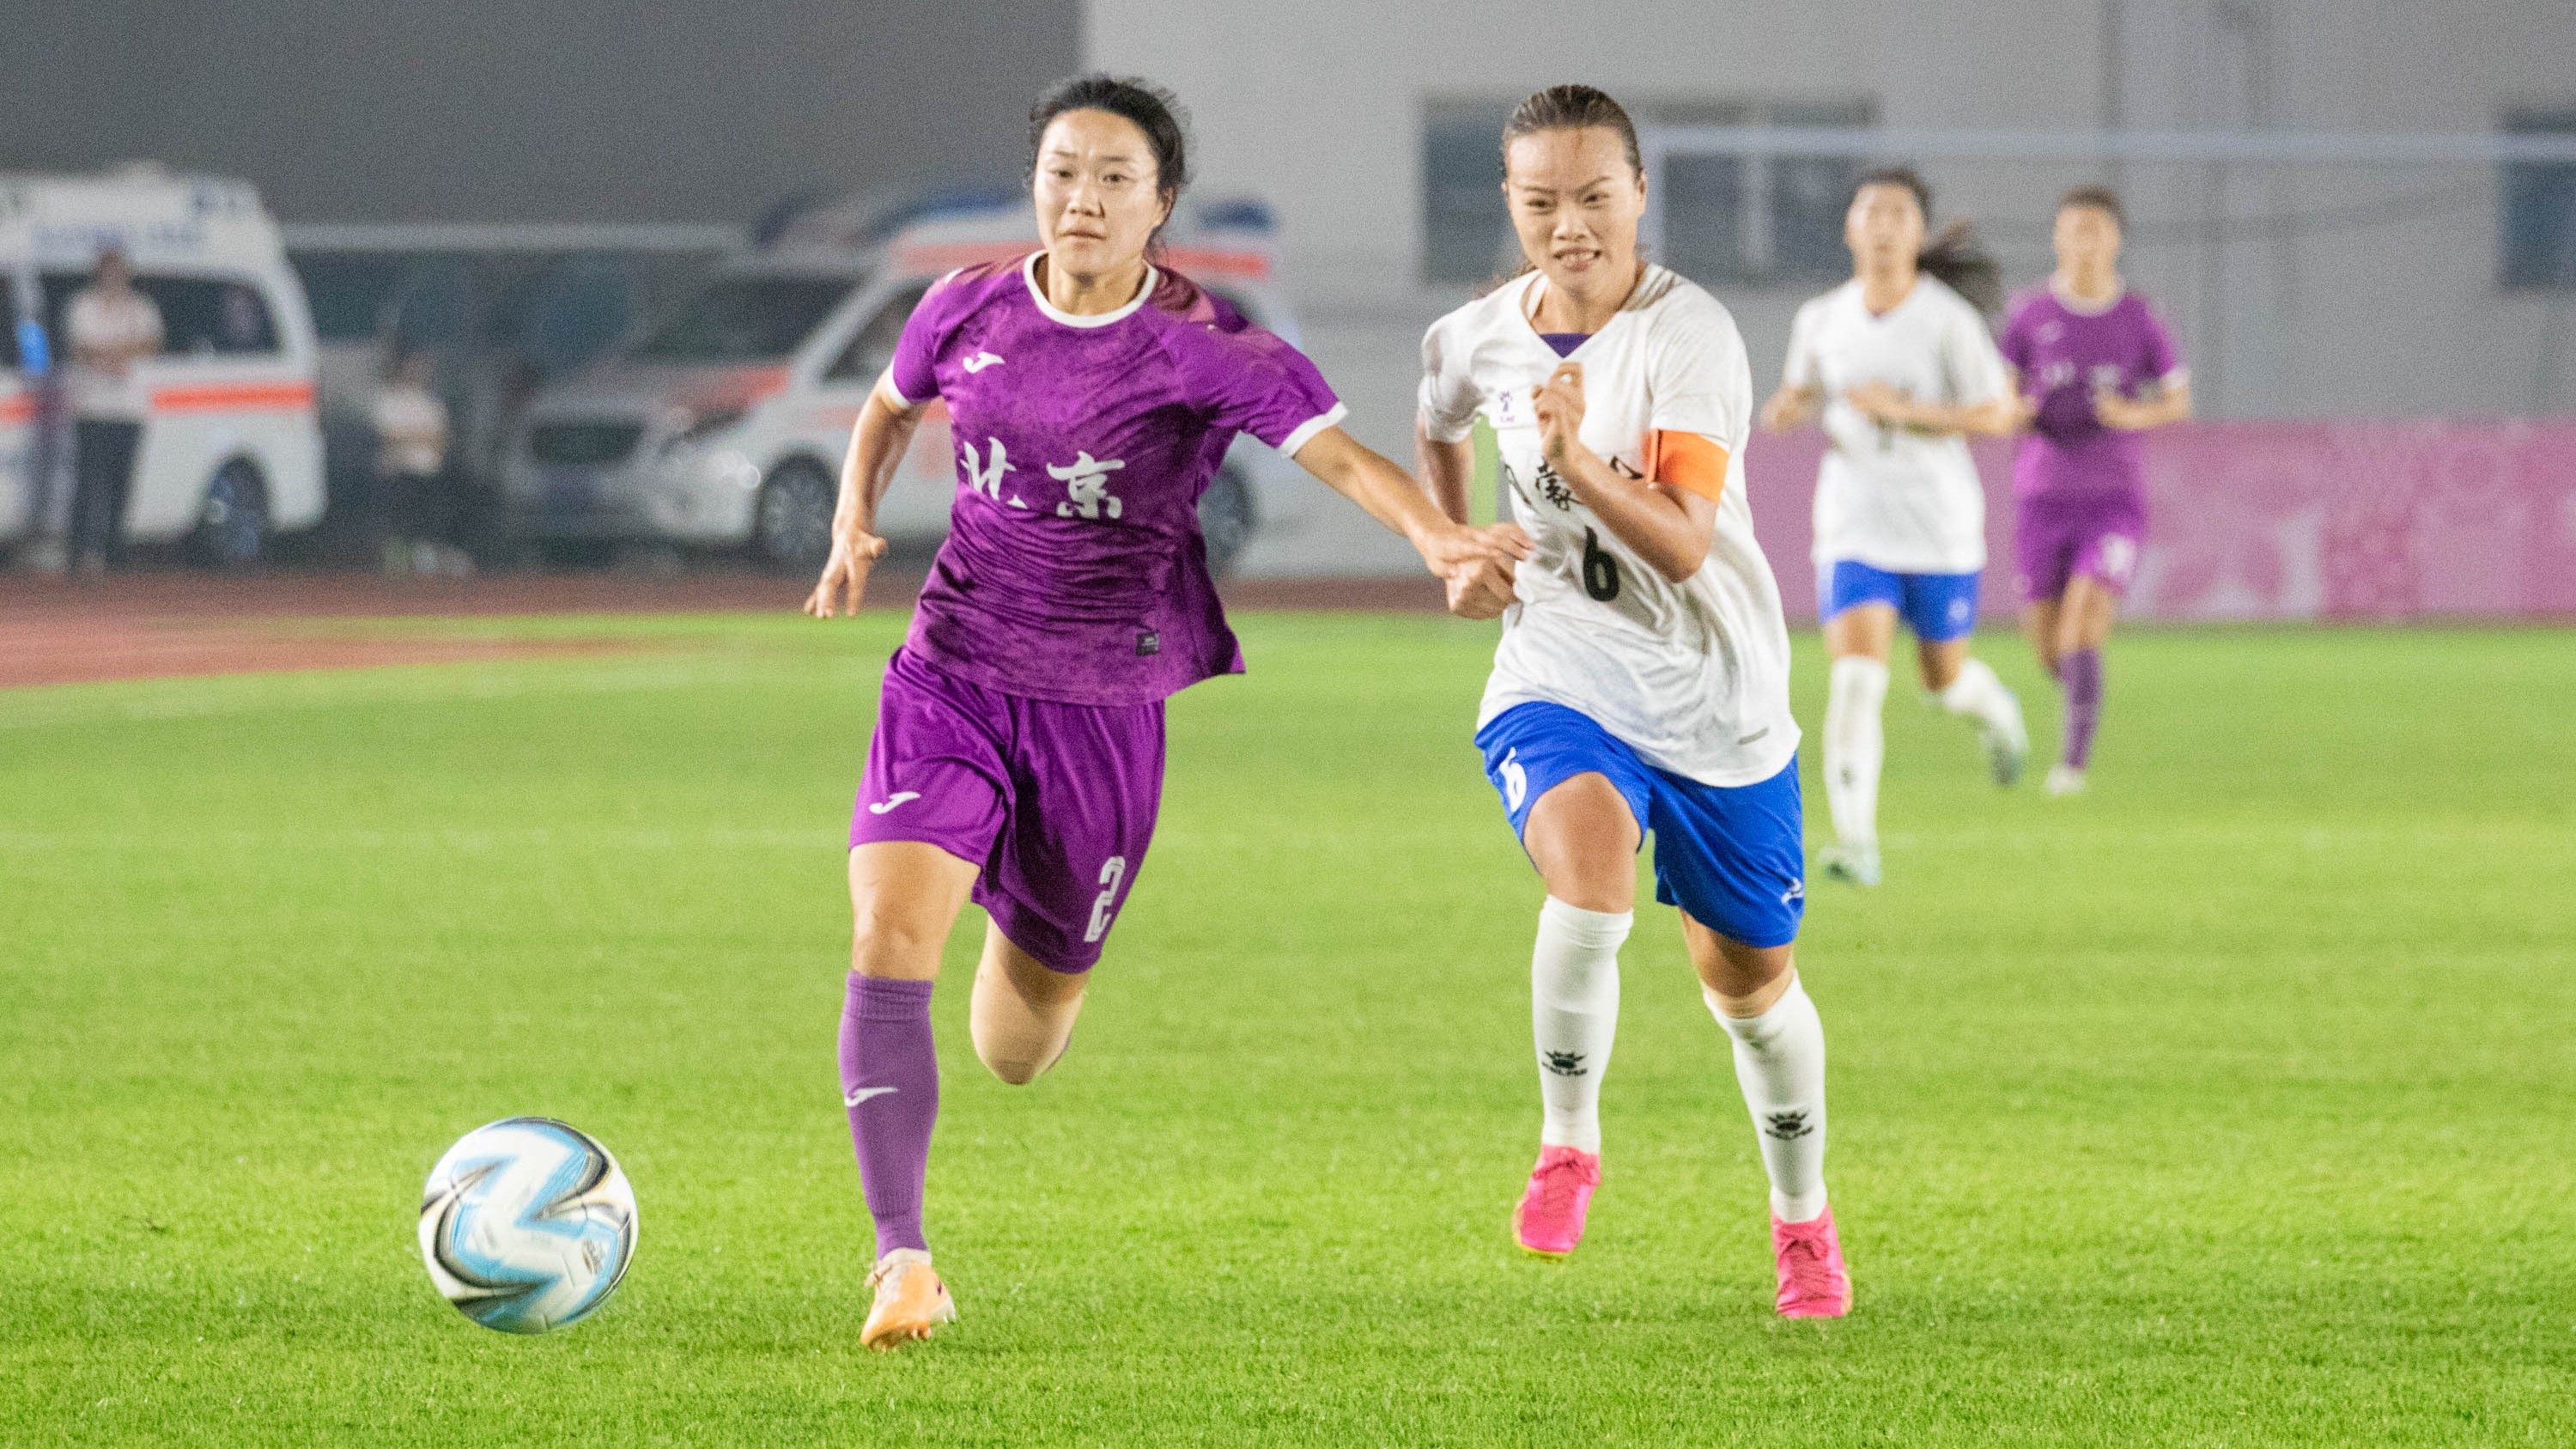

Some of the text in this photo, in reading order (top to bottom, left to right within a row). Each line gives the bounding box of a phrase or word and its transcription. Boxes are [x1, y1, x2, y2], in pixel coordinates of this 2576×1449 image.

[959, 436, 1126, 519] 北京
[1583, 525, 1619, 602] 6
[1498, 746, 1528, 813] 6
[1084, 855, 1126, 942] 2
